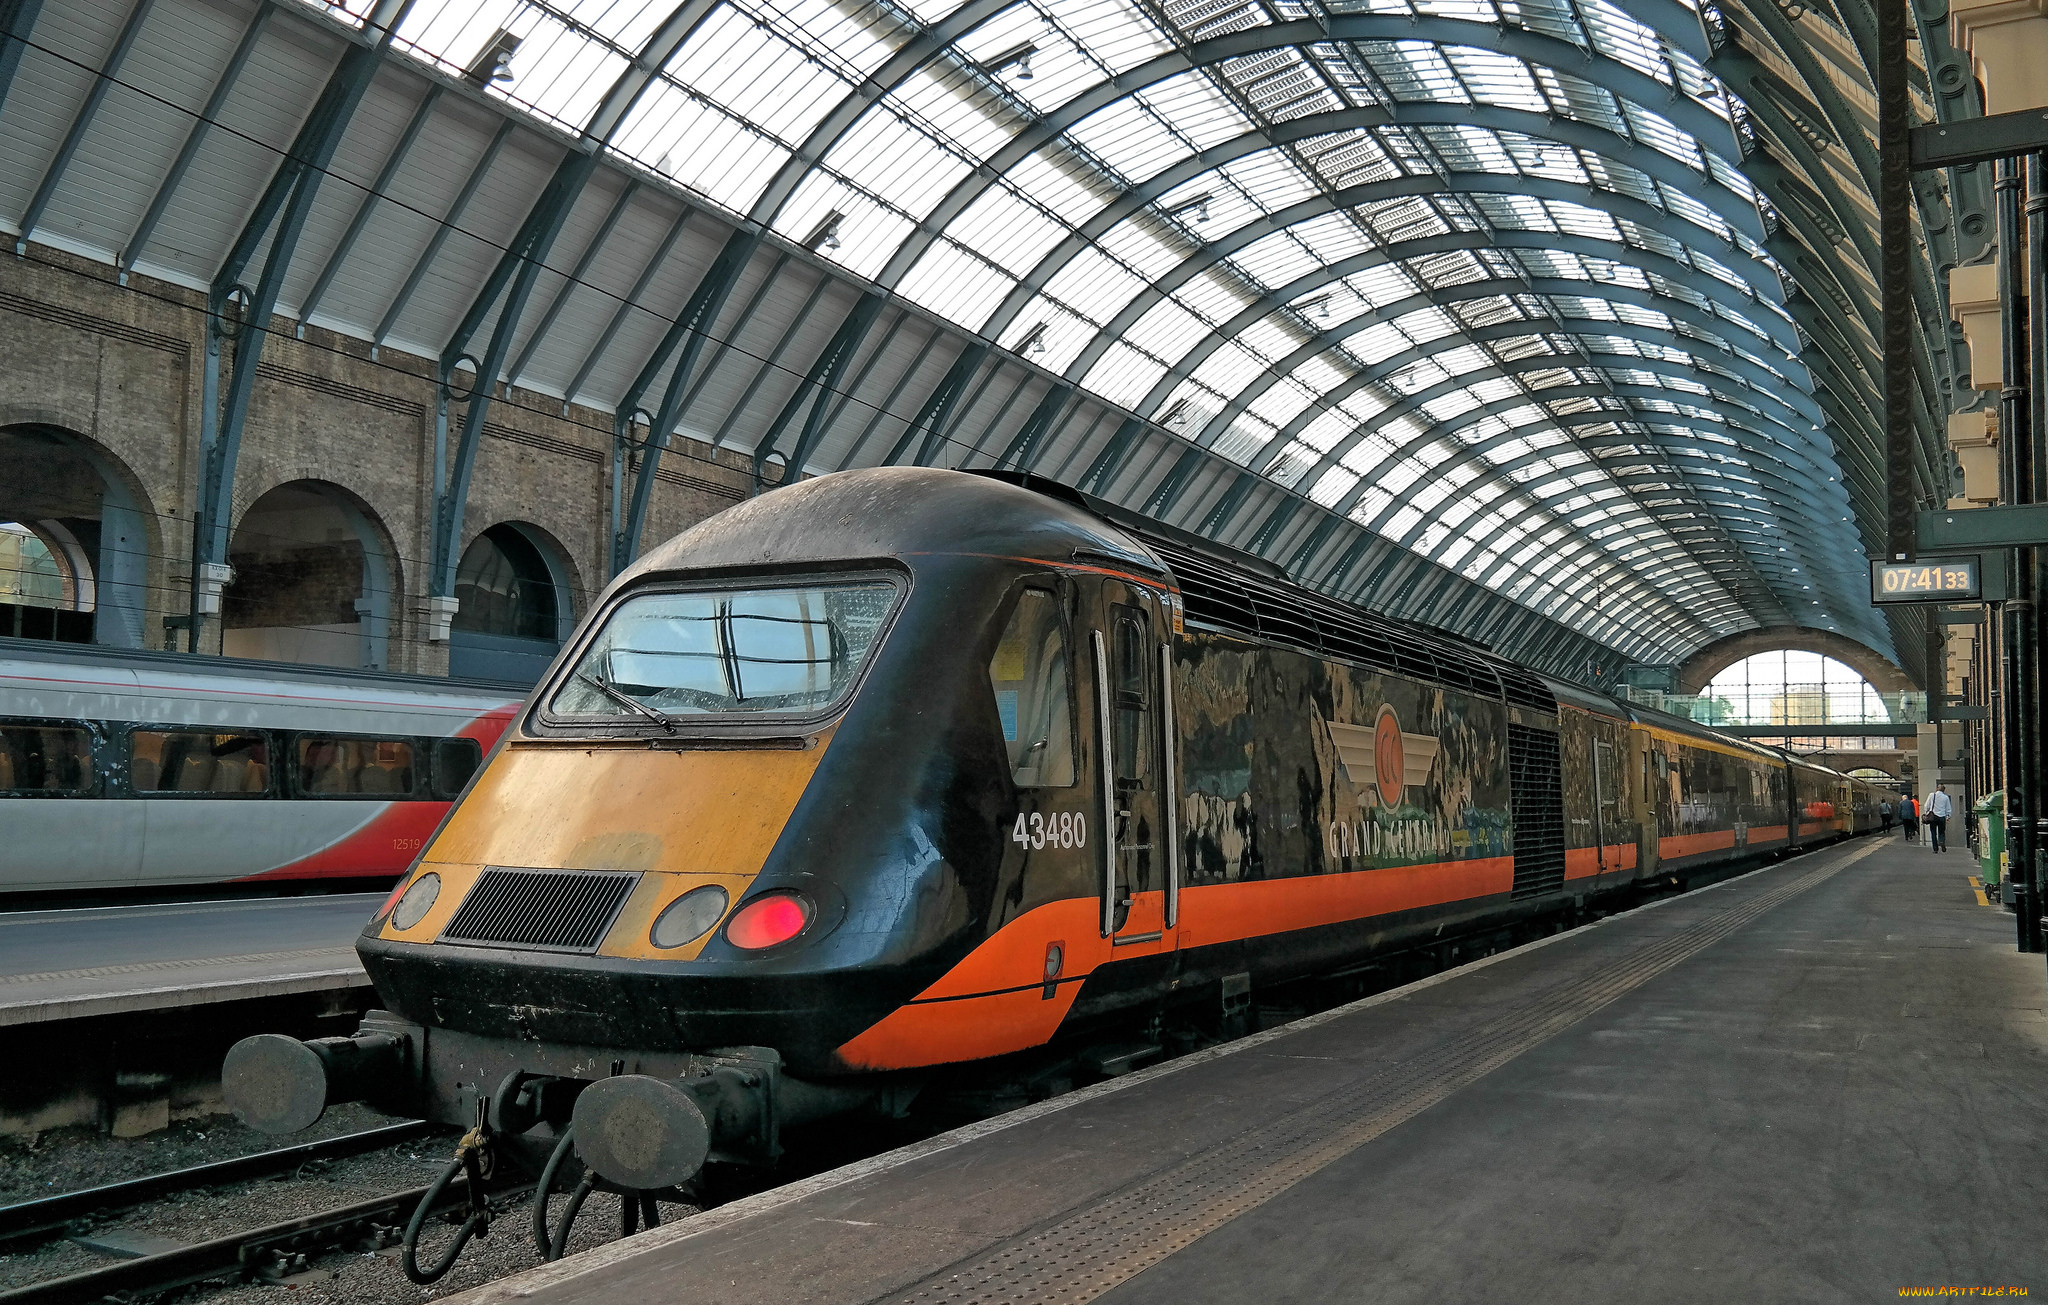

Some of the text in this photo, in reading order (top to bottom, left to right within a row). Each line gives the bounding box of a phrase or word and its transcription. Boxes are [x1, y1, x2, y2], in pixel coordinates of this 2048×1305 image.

[393, 838, 421, 850] 12519
[1012, 811, 1087, 850] 43480
[1329, 820, 1381, 858] GRAND
